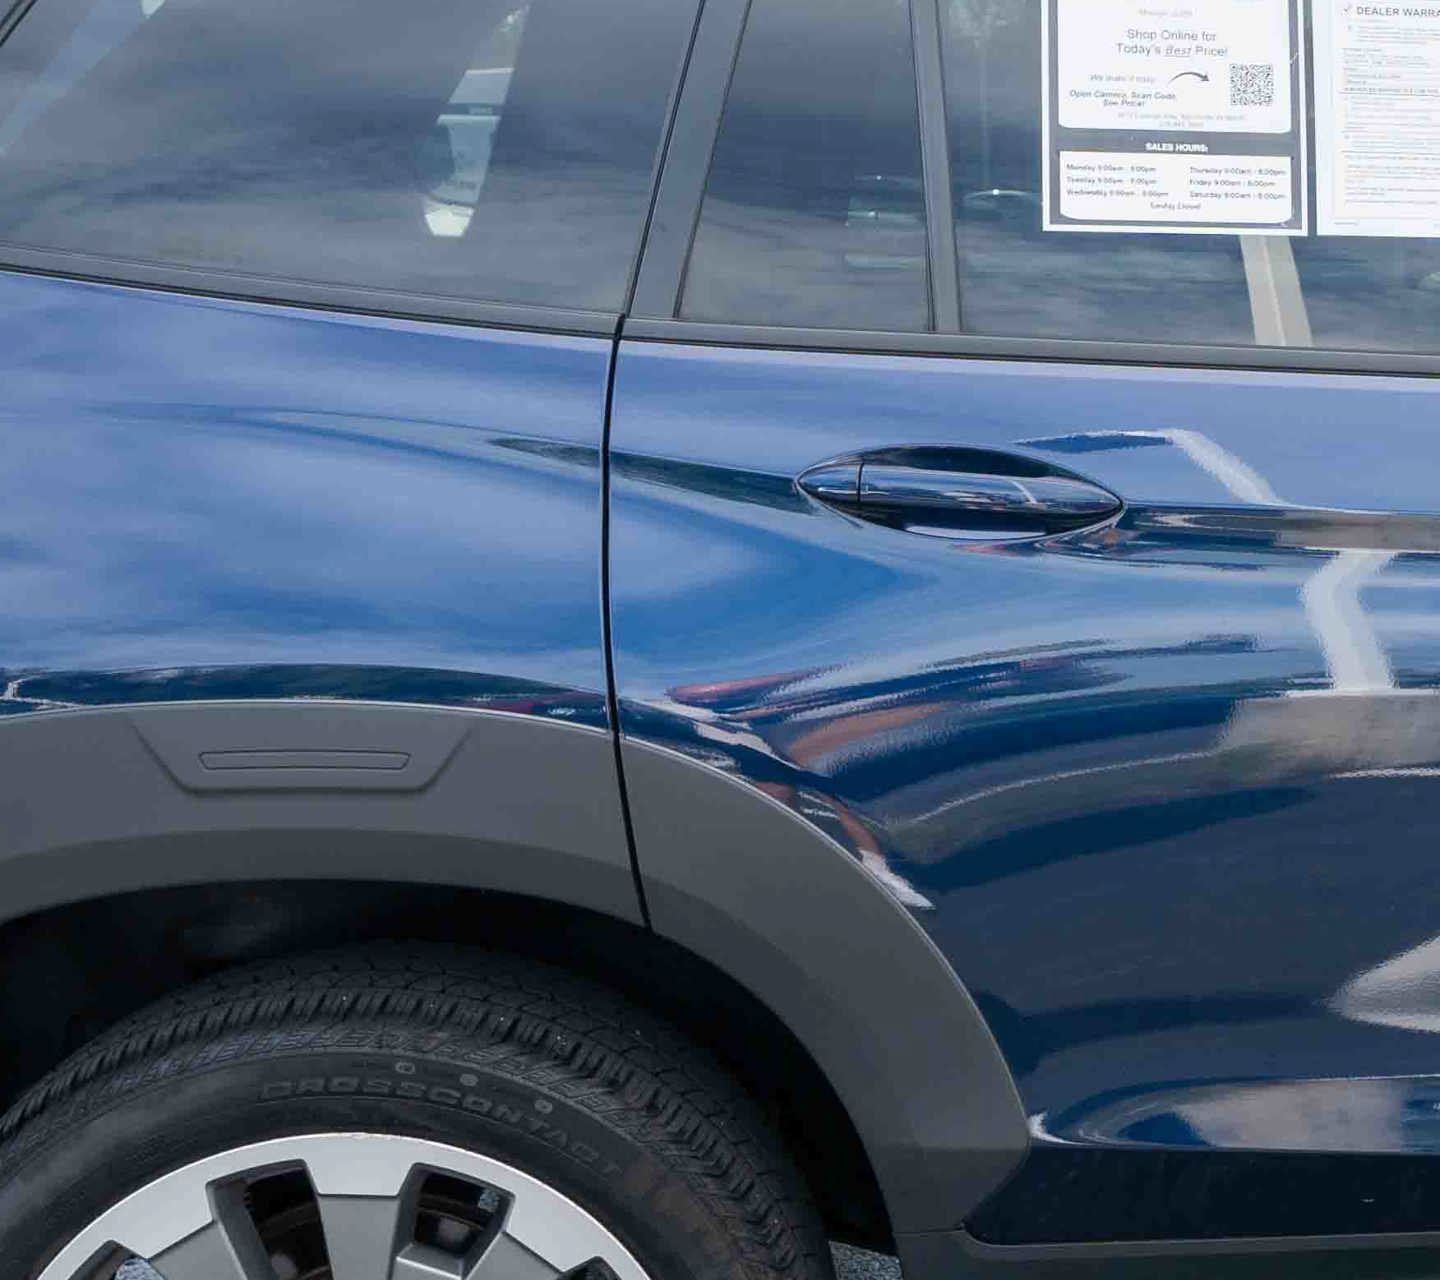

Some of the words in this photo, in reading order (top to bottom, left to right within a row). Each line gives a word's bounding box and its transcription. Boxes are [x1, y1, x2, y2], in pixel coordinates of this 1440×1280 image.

[1356, 6, 1400, 17] DEALER
[1126, 29, 1157, 42] Shop
[1160, 29, 1199, 41] Online
[1202, 30, 1216, 42] for
[1116, 42, 1161, 57] Today's
[1145, 142, 1173, 152] SALES
